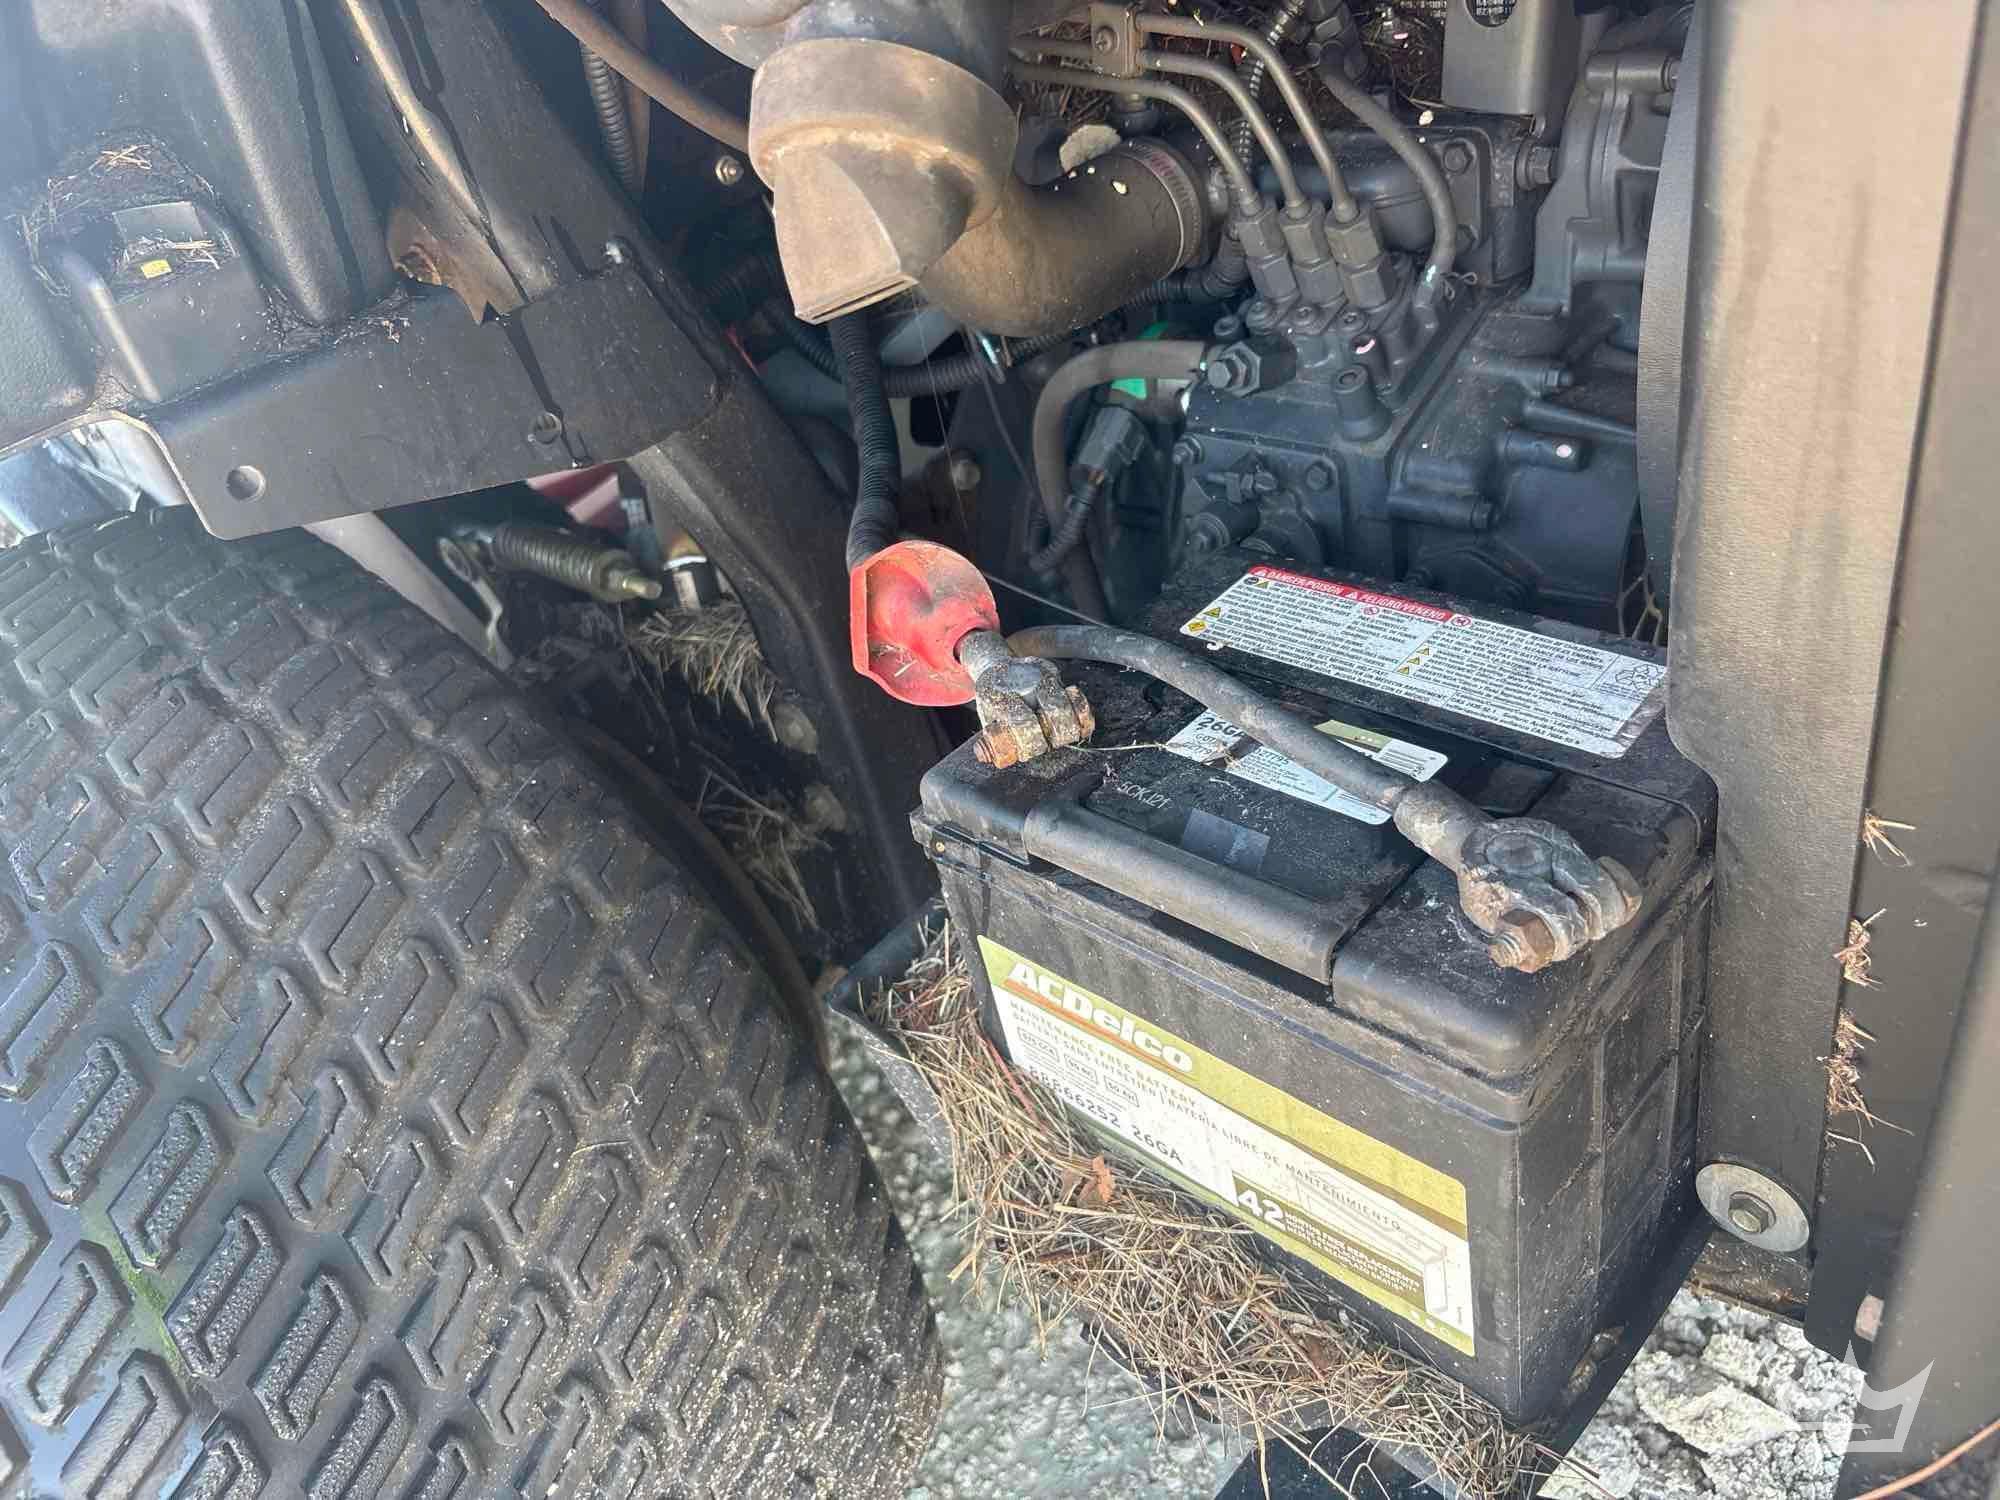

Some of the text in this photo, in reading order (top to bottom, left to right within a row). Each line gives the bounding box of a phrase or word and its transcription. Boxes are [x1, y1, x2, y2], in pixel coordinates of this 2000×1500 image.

[1008, 962, 1193, 1073] ACDelco
[1010, 1001, 1094, 1051] MAINTENANCE
[1100, 1048, 1131, 1074] FREE
[1135, 1069, 1196, 1107] BATTERY
[1131, 1123, 1185, 1166] 26GA
[1238, 1189, 1286, 1231] 42
[1262, 1148, 1281, 1167] DE
[1285, 1163, 1401, 1231] MANTENIMIENTO
